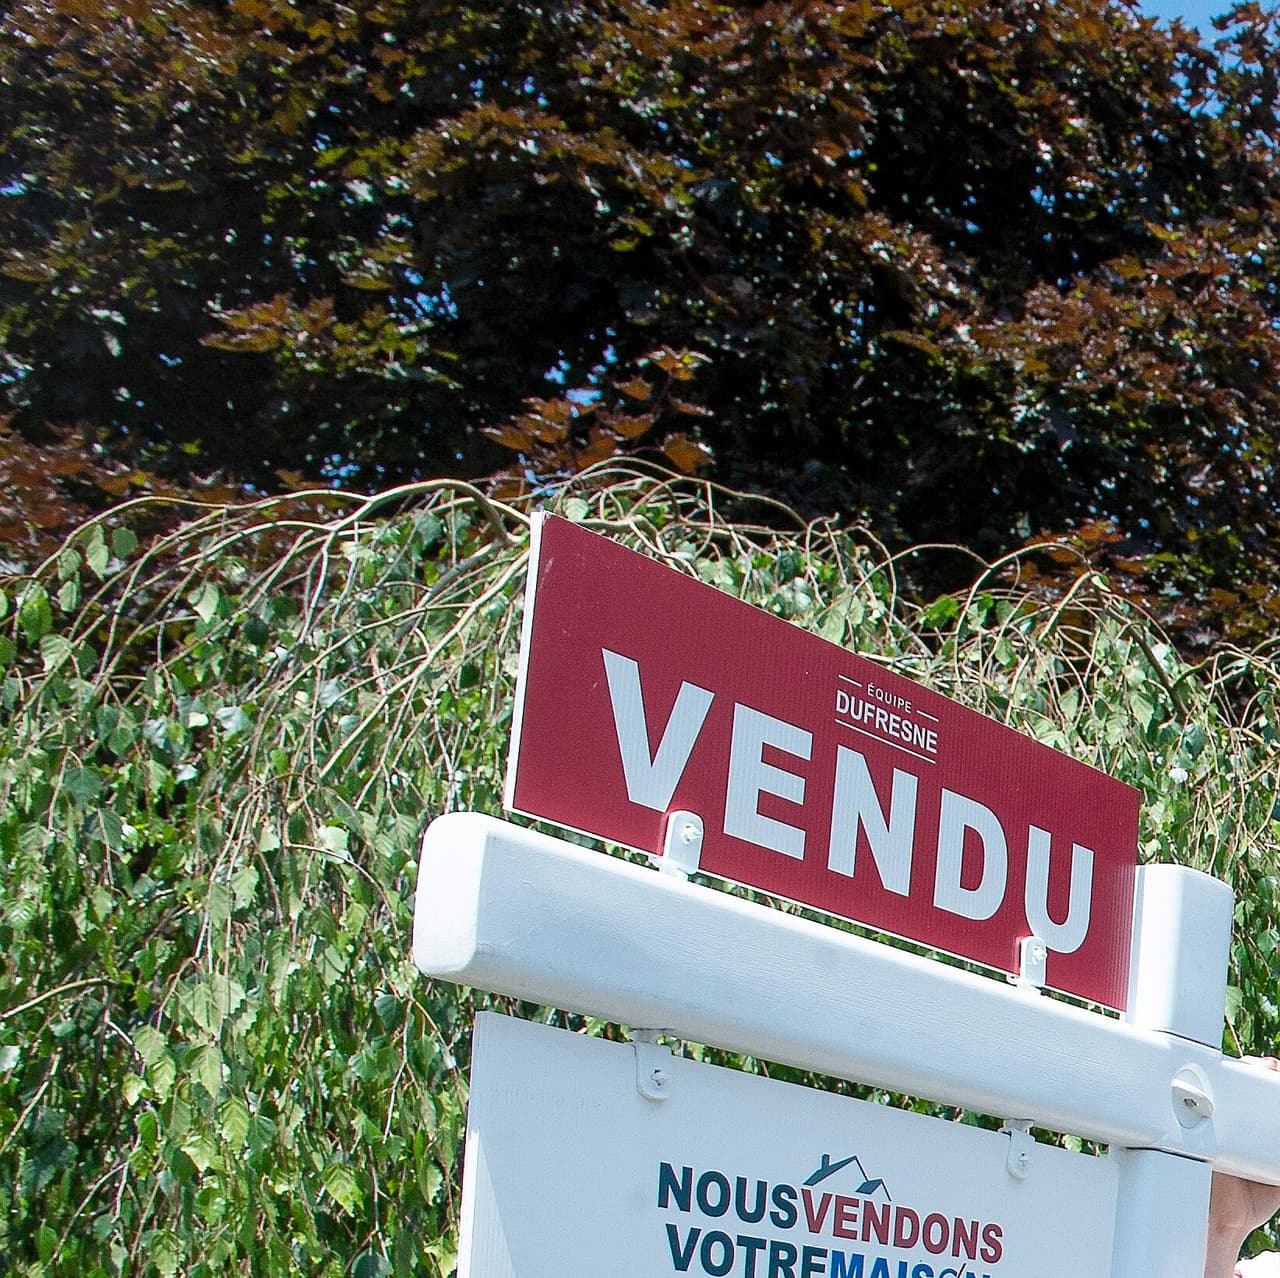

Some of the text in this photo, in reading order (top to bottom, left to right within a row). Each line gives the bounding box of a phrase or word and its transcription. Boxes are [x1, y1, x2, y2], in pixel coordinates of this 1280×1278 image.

[836, 689, 938, 754] DUFRESNE
[867, 682, 912, 714] ÉQUIPE
[601, 647, 1094, 955] VENDU
[657, 1161, 1005, 1265] NOUSVENDONS
